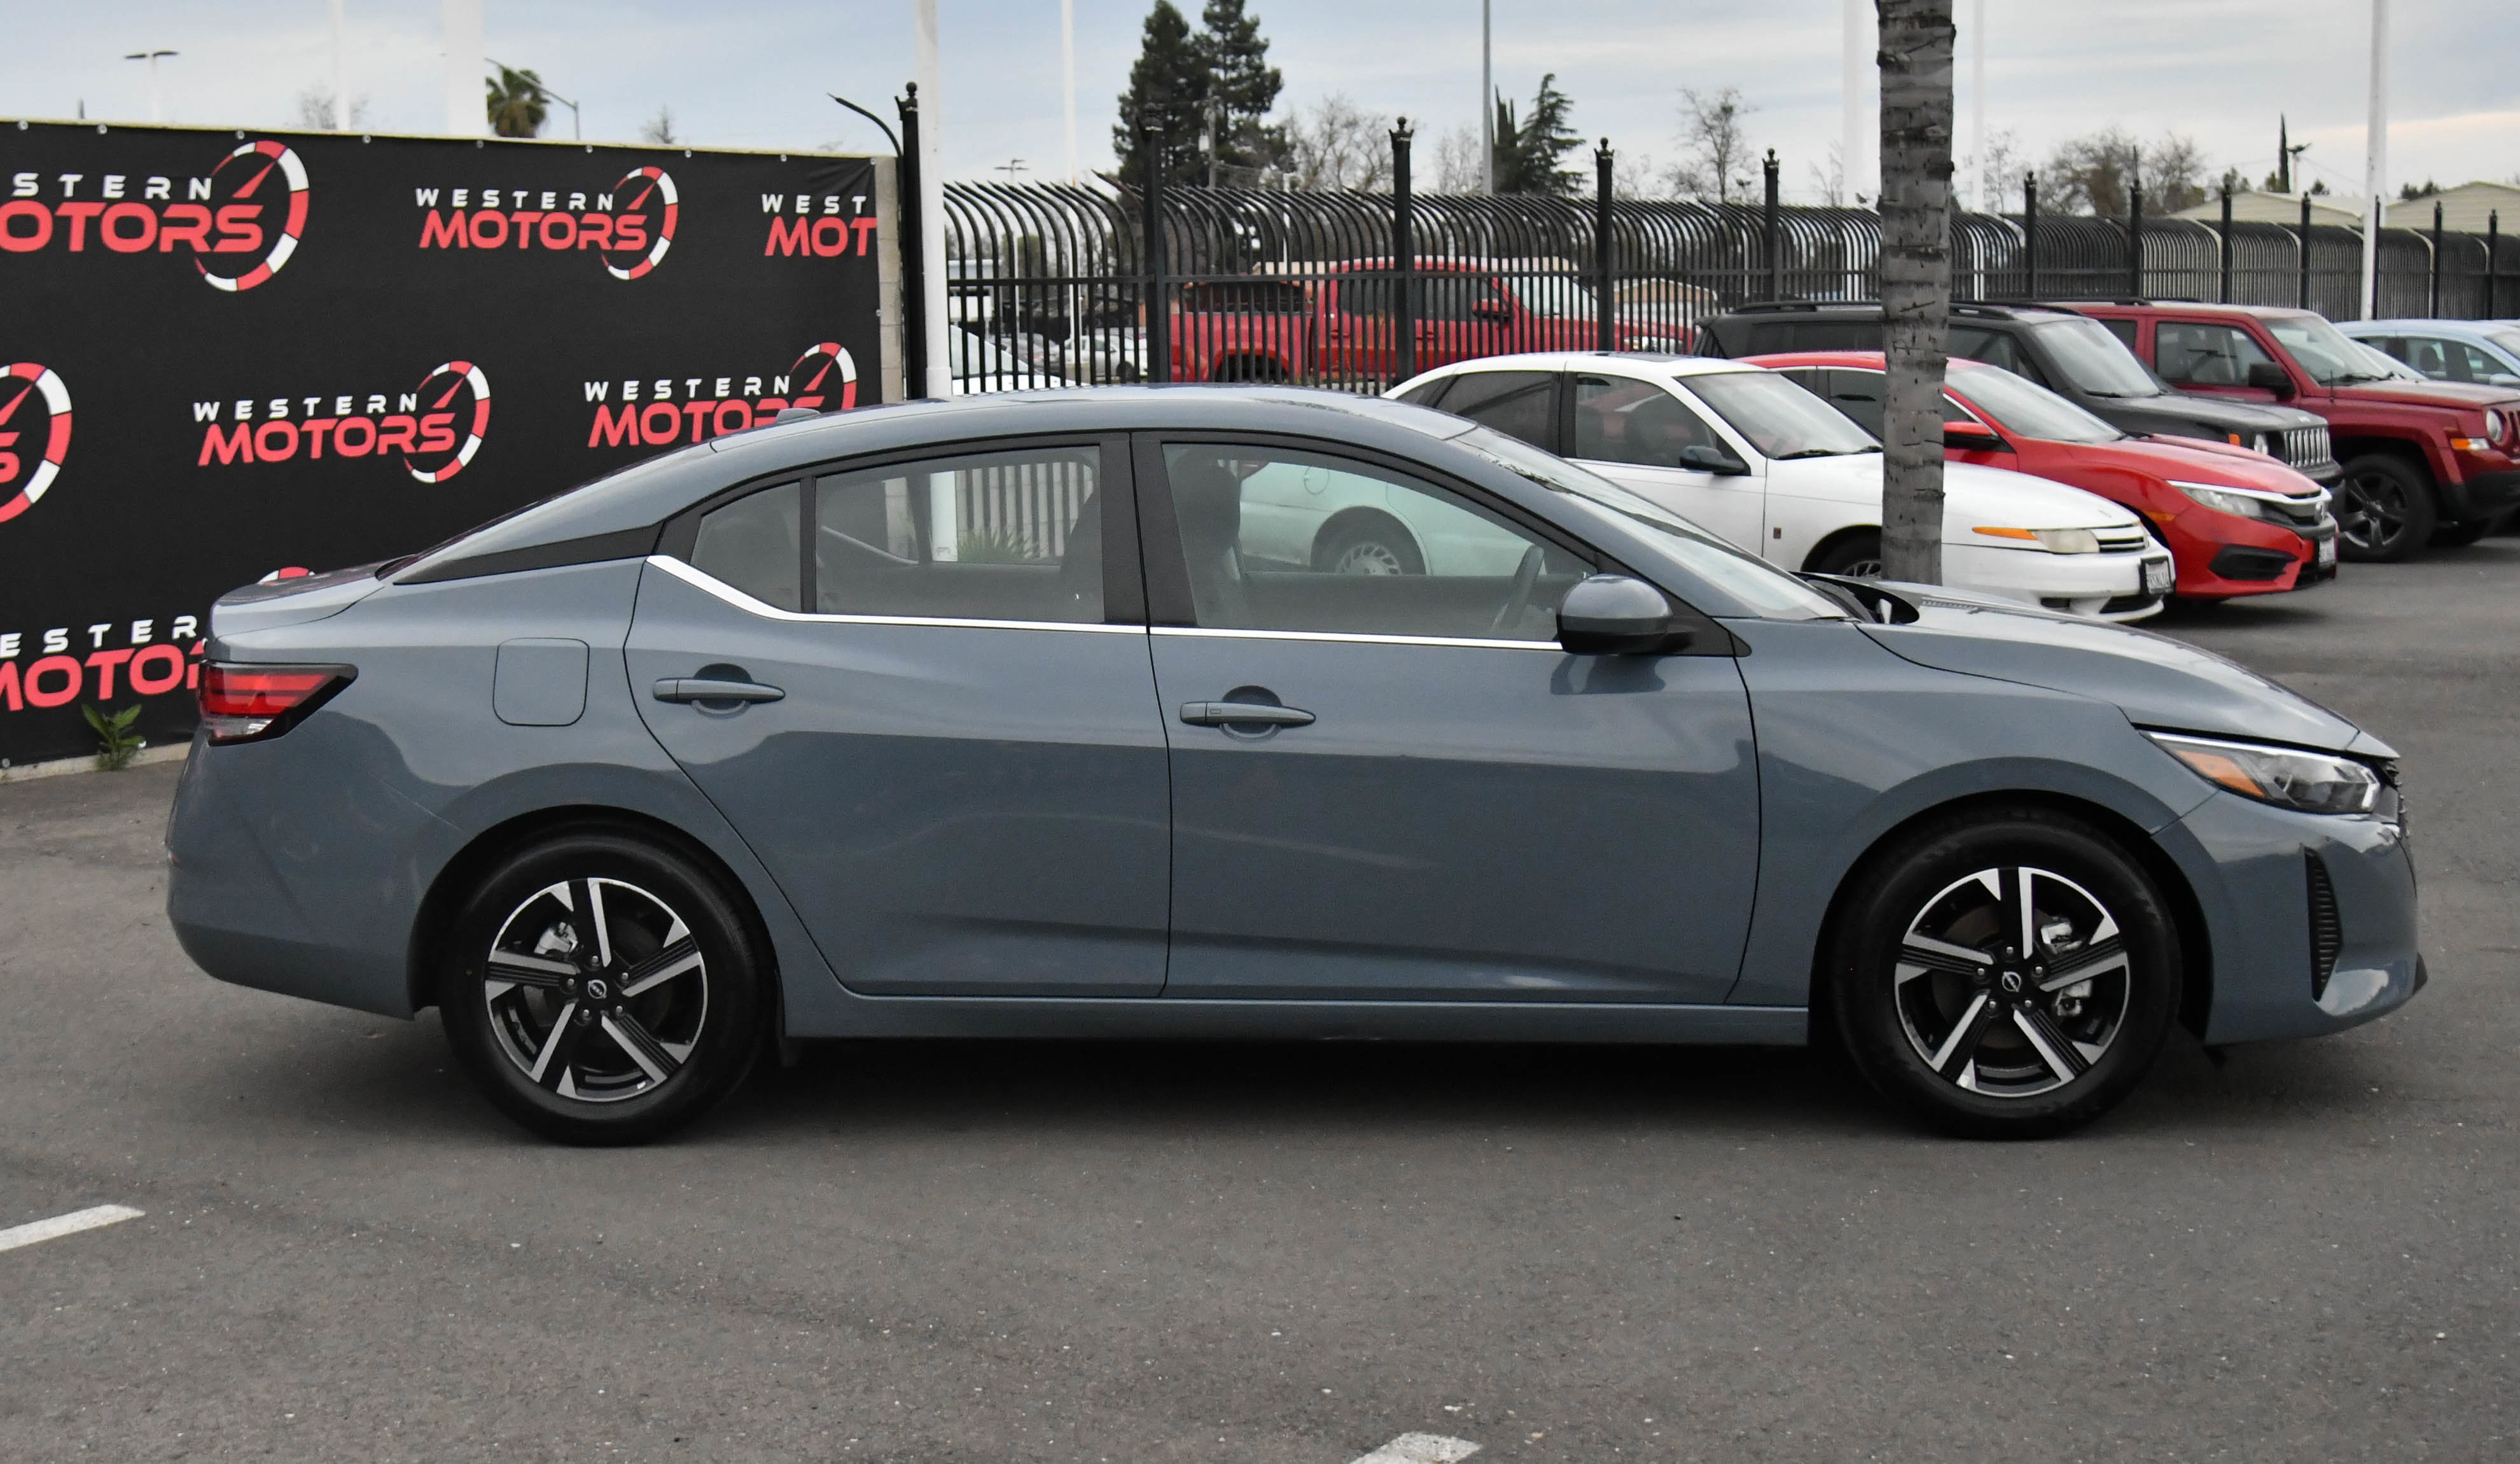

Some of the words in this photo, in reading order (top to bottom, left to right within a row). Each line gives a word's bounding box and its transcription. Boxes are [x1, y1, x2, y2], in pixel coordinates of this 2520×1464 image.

[11, 172, 212, 201] STERN
[415, 188, 614, 211] WESTERN
[762, 193, 867, 214] WEST
[0, 200, 263, 253] OTORS
[419, 209, 647, 251] MOTORS
[765, 216, 878, 257] MOT
[584, 375, 790, 402] WESTERN
[193, 393, 417, 422] WESTERN
[198, 412, 456, 466] MOTORS
[0, 615, 197, 659] ESTER
